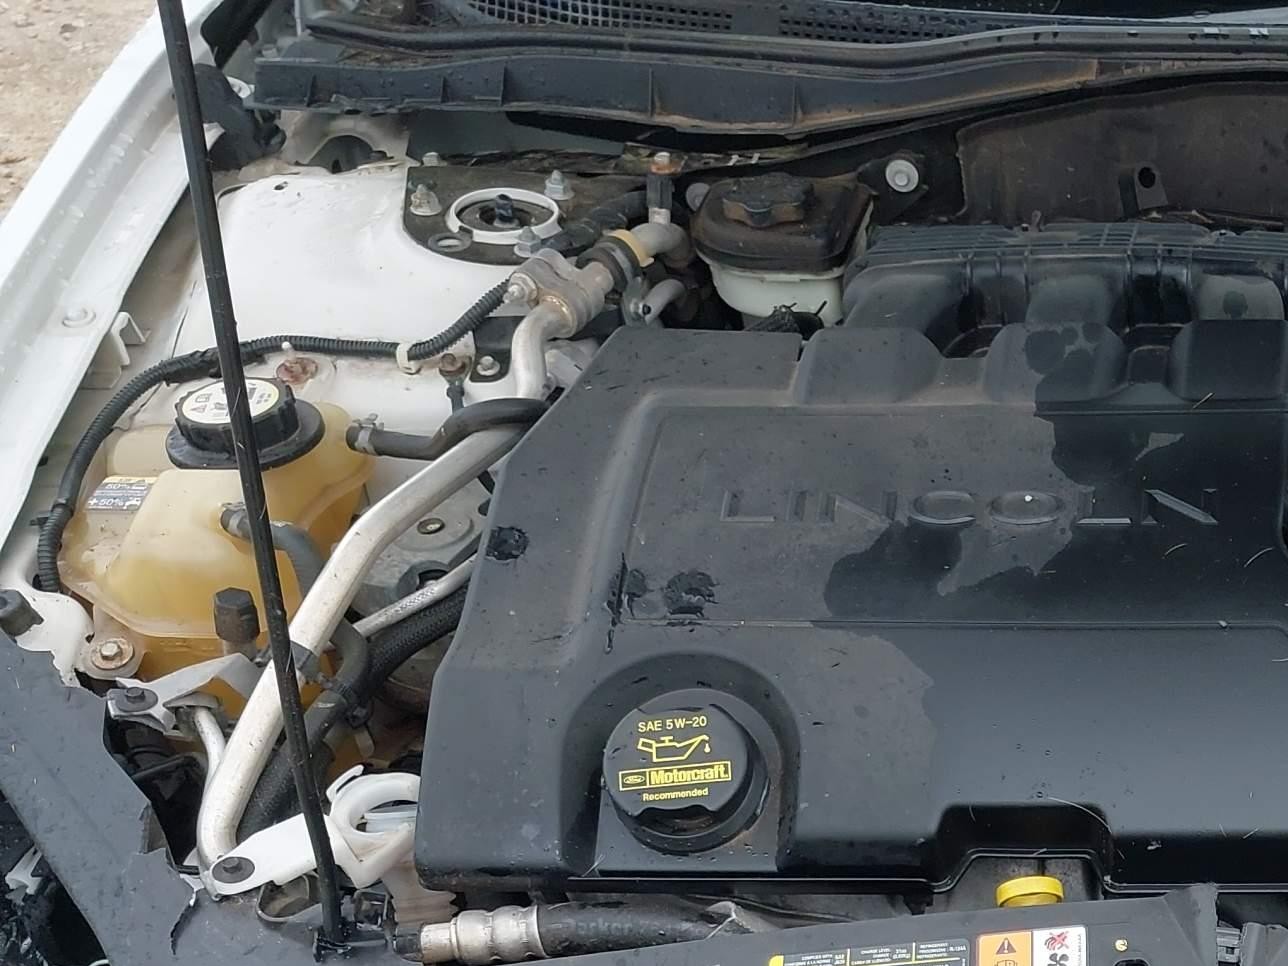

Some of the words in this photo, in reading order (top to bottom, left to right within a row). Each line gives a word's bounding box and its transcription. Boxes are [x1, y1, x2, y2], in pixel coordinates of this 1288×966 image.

[719, 487, 1220, 528] LINCOLN
[638, 720, 663, 732] SAE
[666, 715, 708, 730] 5W-20
[642, 788, 709, 801] Recommended
